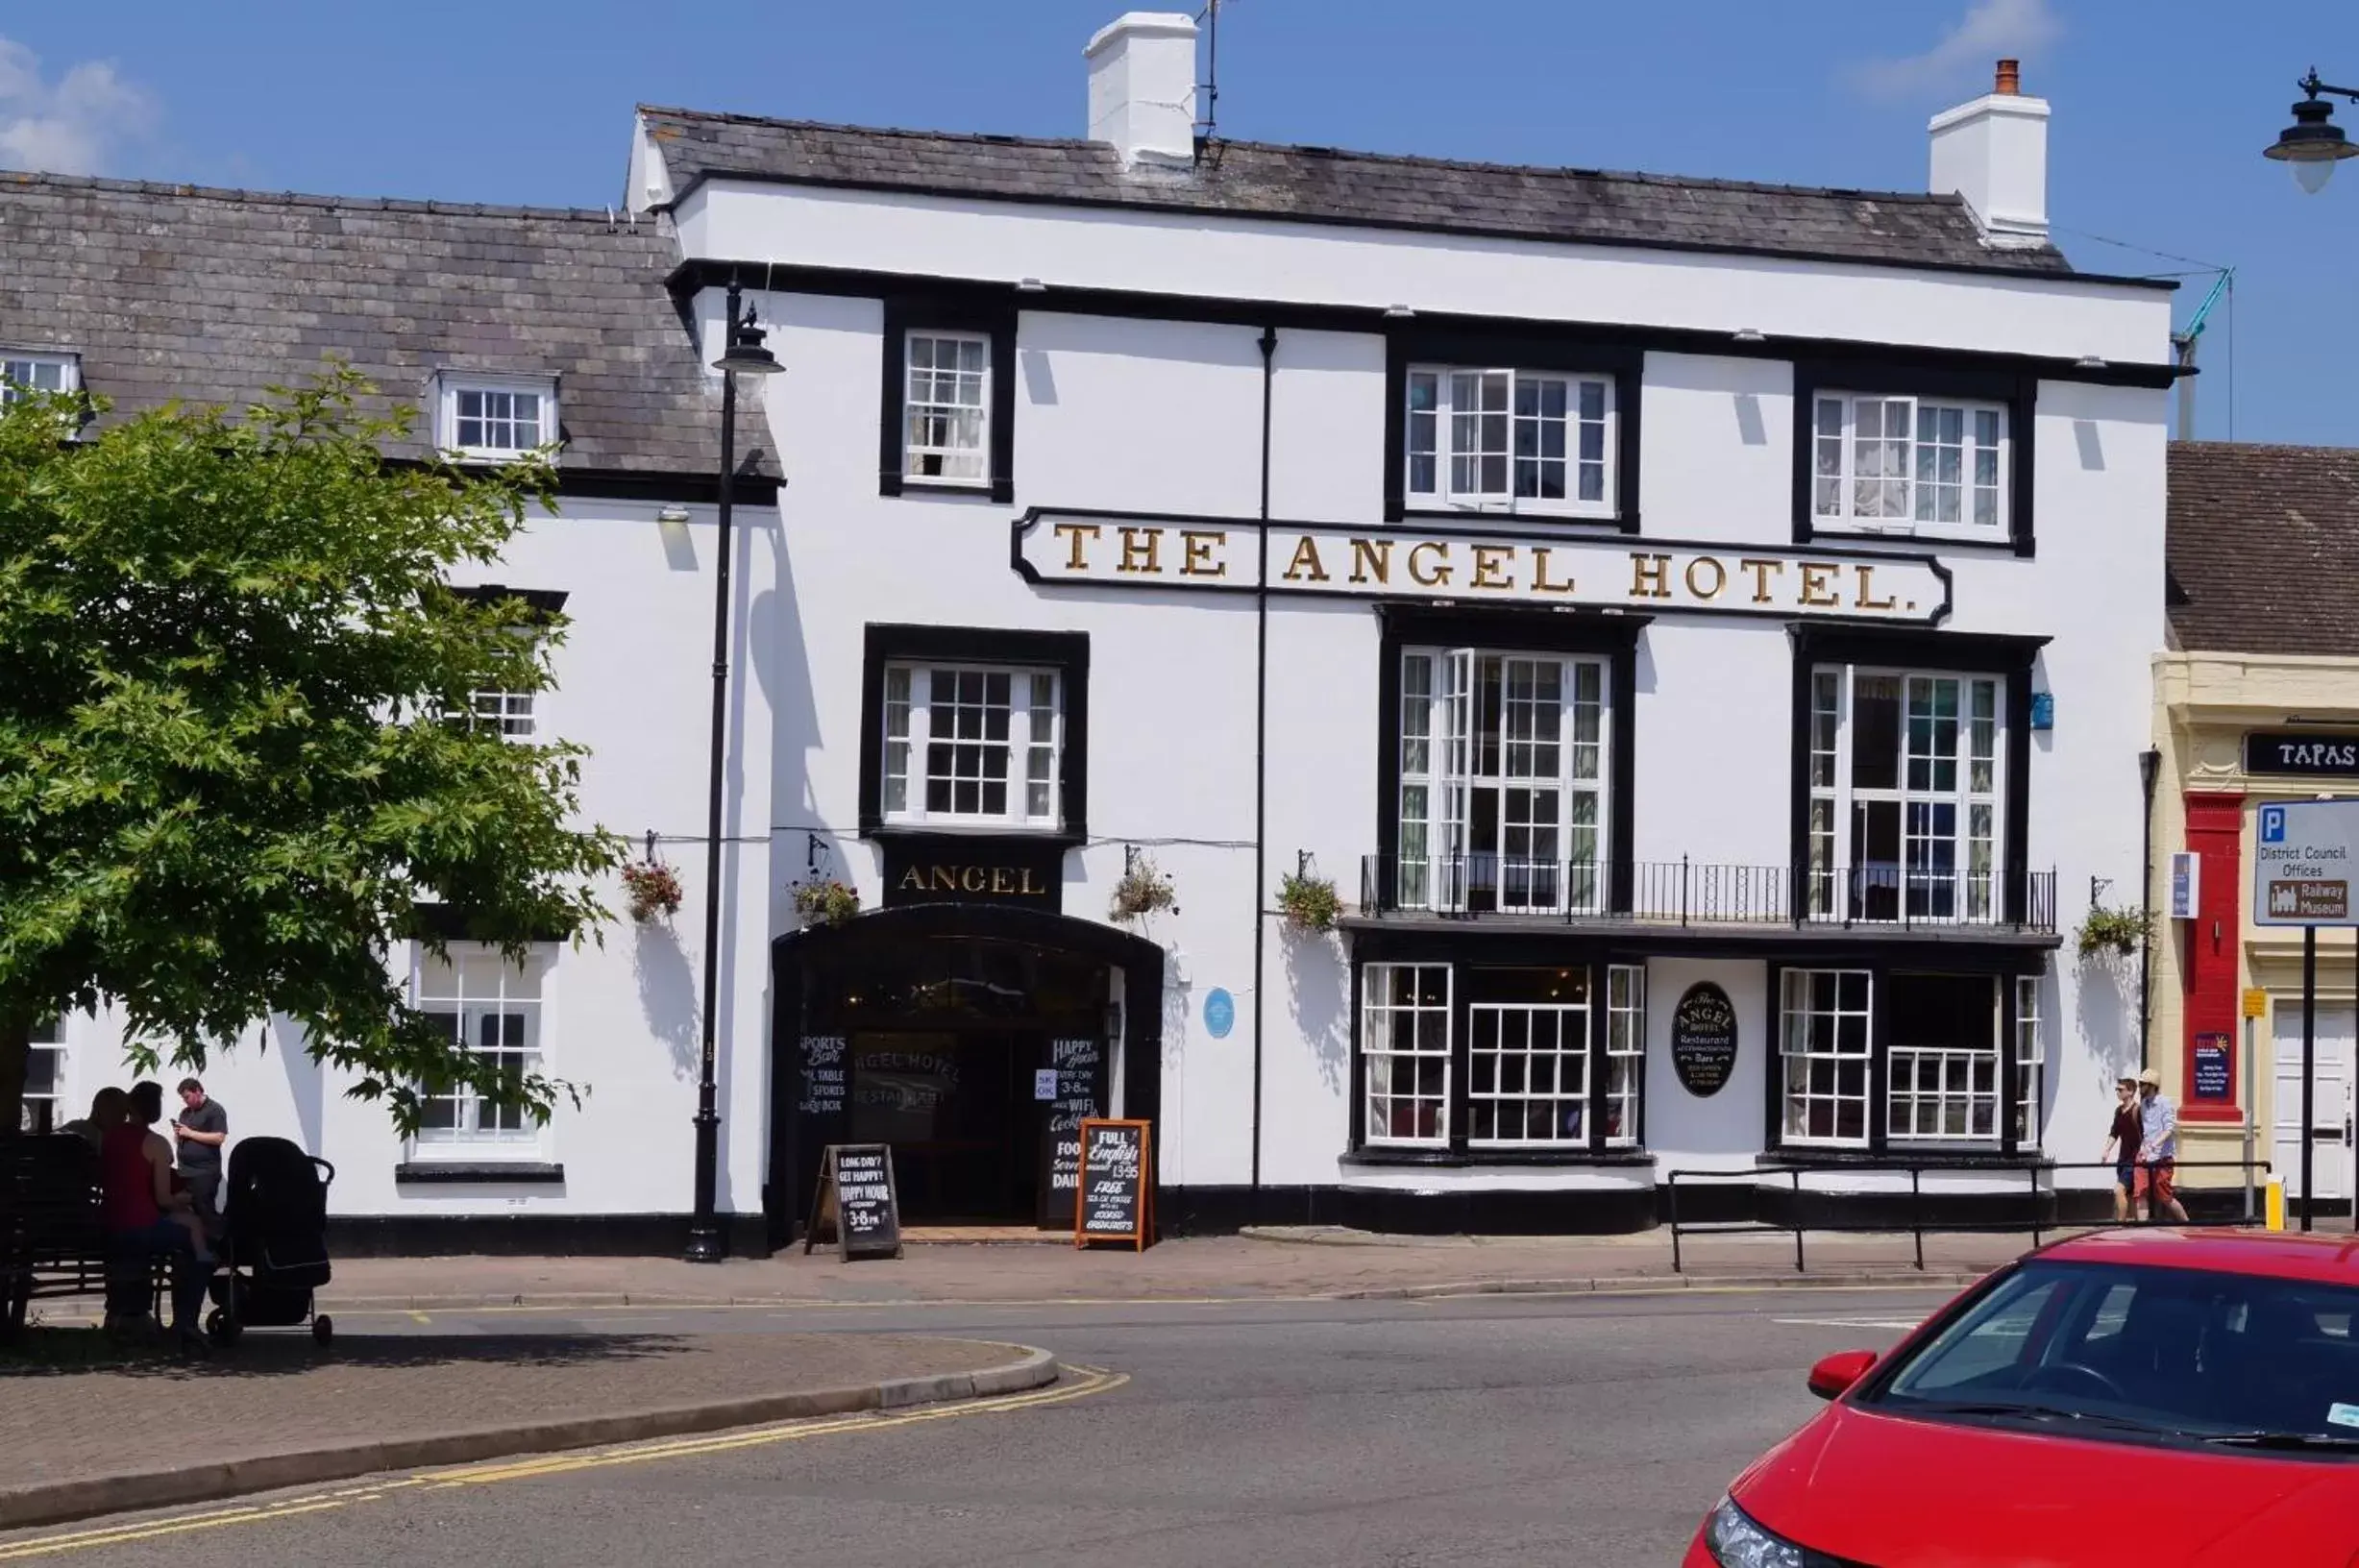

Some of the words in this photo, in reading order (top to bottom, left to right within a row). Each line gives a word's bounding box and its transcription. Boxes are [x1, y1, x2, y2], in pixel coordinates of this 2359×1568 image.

[1054, 524, 1226, 576] THE
[1283, 535, 1576, 592] ANGEL
[1629, 552, 1917, 611] HOTEL.
[2278, 744, 2357, 767] TAPAS
[2266, 810, 2281, 840] P
[2261, 847, 2300, 860] District
[2305, 846, 2347, 860] Council
[2282, 864, 2323, 877] Offices
[899, 864, 1045, 894] ANGEL
[2301, 883, 2345, 900] Railway
[2300, 901, 2346, 916] Museum
[1679, 1008, 1731, 1029] ANGEL
[1681, 1034, 1730, 1045] Restaurant
[1053, 1040, 1093, 1064] HAPPY
[818, 1068, 844, 1082] TABLE
[1098, 1132, 1127, 1145] FULL
[1058, 1141, 1081, 1156] FOO
[1088, 1142, 1138, 1165] English
[840, 1157, 860, 1168] LONG
[839, 1171, 851, 1182] GET
[1053, 1173, 1079, 1188] DAI
[840, 1185, 864, 1203] HAPPY
[865, 1185, 889, 1201] HOUR
[1093, 1180, 1126, 1194] FREE
